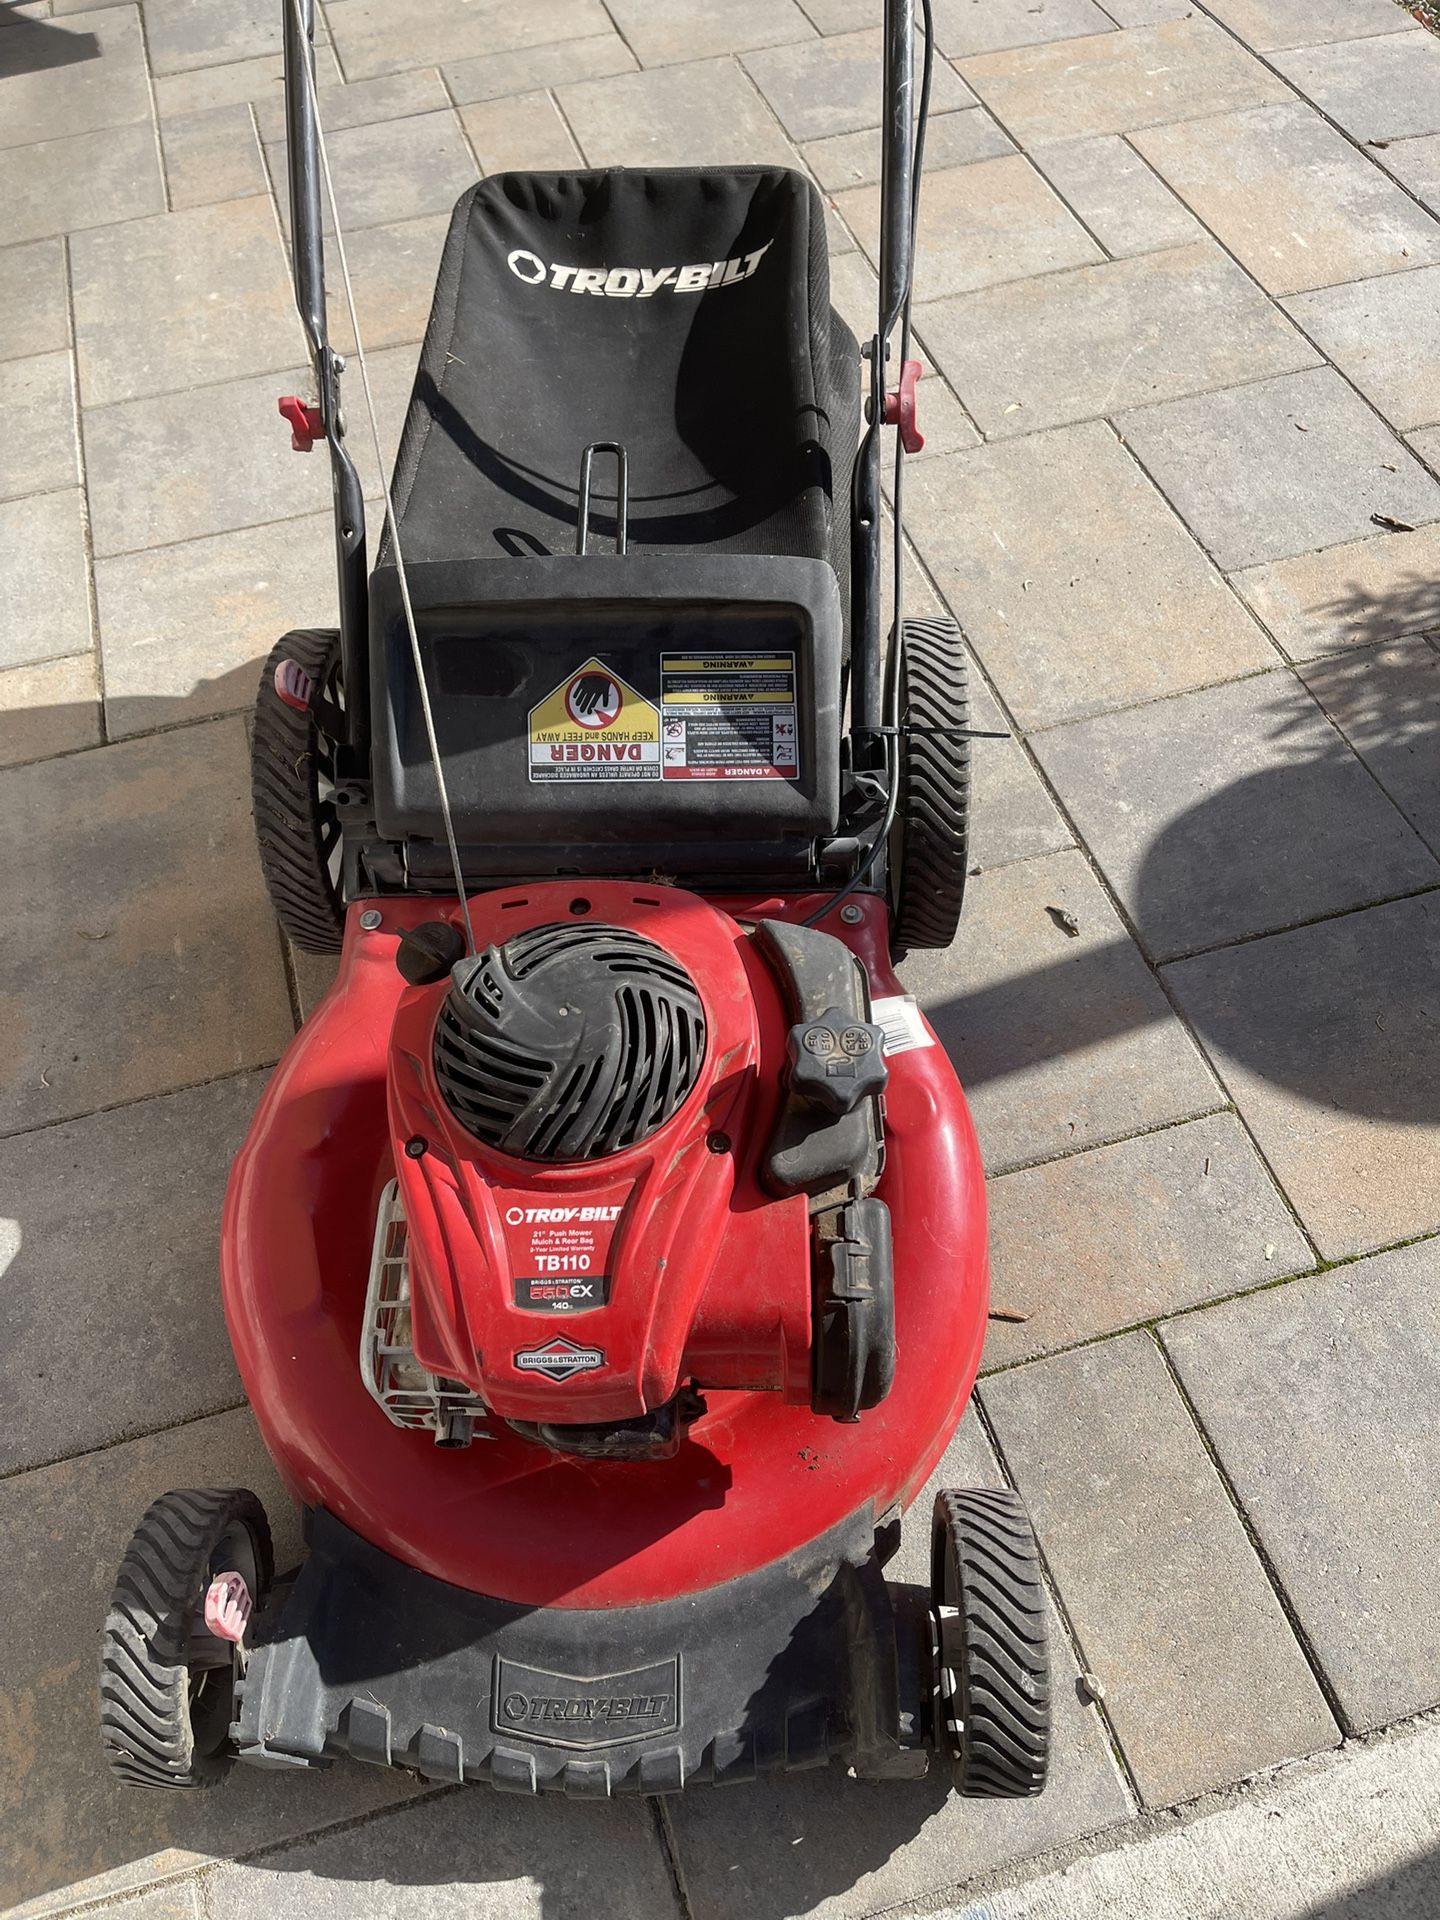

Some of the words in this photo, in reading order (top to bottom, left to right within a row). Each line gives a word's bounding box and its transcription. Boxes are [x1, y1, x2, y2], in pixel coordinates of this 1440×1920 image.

[549, 238, 774, 298] TROY-BILT
[703, 693, 747, 701] WARNING
[536, 732, 560, 741] AWAY
[562, 732, 583, 741] FEET
[585, 732, 599, 741] and
[601, 732, 630, 740] HANDS
[632, 732, 653, 740] KEEP
[551, 744, 641, 761] DANGER
[821, 1032, 830, 1050] E10
[525, 1207, 622, 1223] TROY-BILT
[534, 1254, 590, 1271] TB110
[530, 1693, 671, 1721] TROY-BILT
